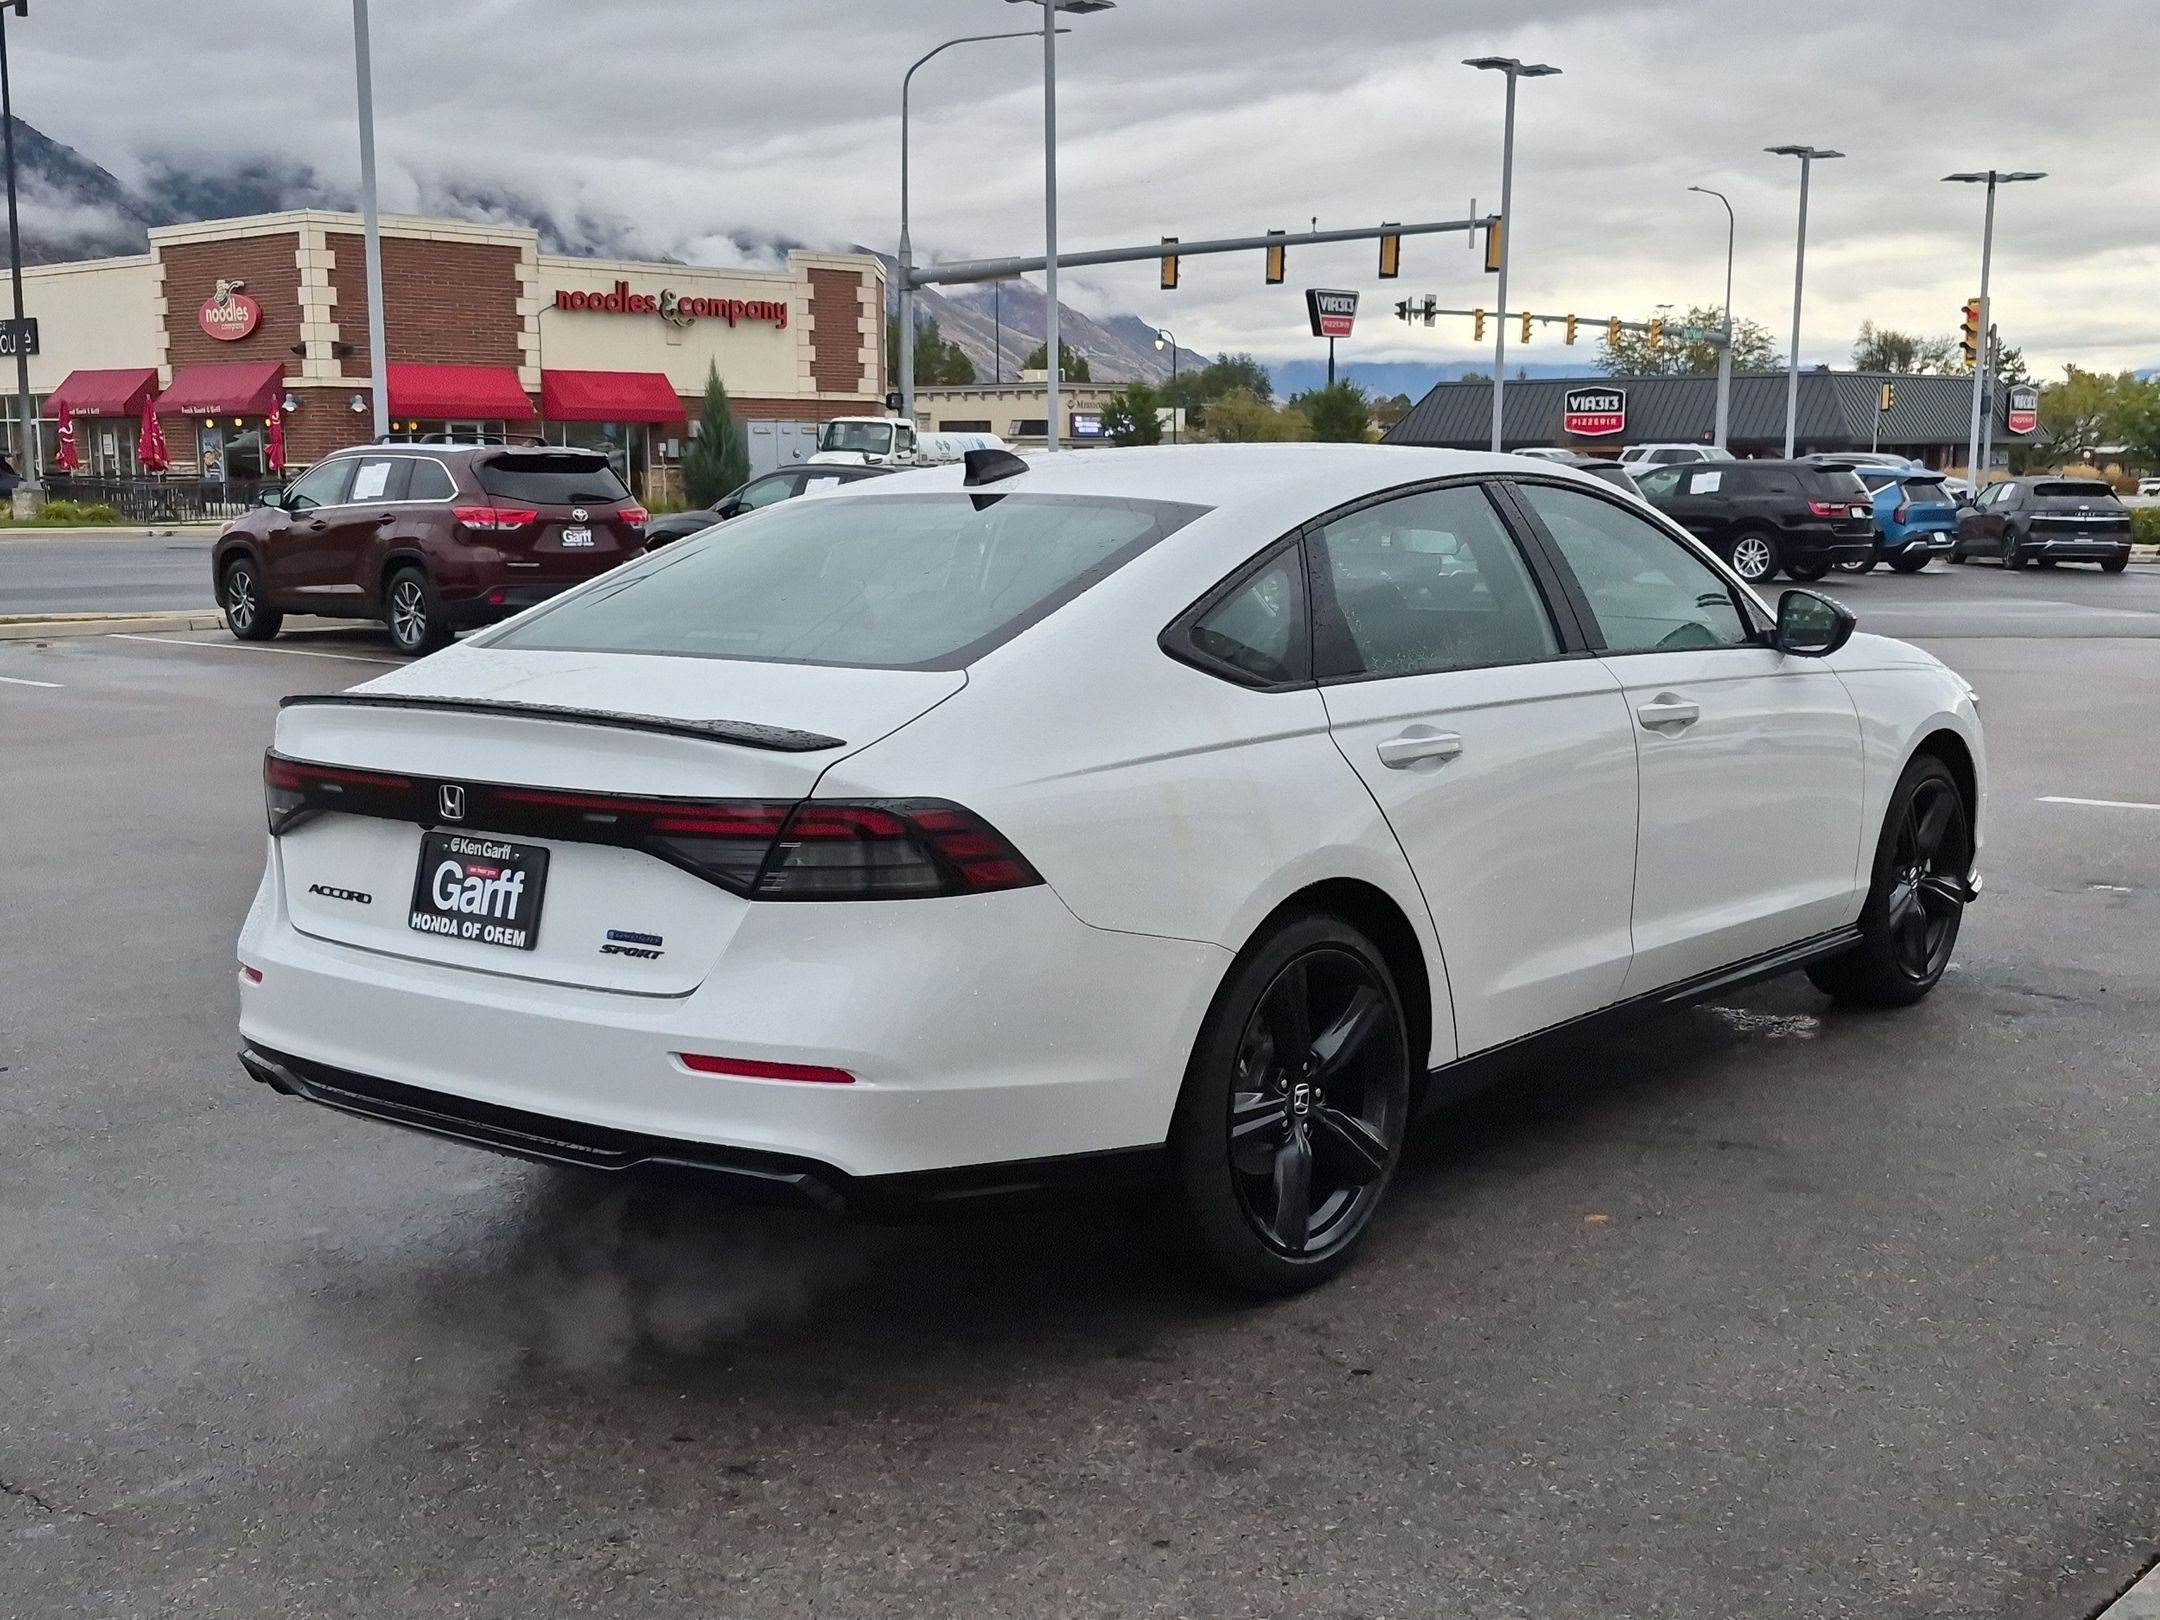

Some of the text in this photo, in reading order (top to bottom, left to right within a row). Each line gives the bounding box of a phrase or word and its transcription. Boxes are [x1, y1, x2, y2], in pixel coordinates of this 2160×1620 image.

[205, 298, 249, 323] noodles
[556, 280, 788, 329] noodles & company
[1569, 396, 1619, 411] VIA313
[1572, 417, 1617, 426] PIZZERIA
[562, 529, 592, 542] Garff
[459, 838, 512, 860] Ken Garff
[308, 883, 373, 905] ACCORD
[432, 860, 526, 920] Garff
[411, 912, 526, 948] HONDA OF OREM
[599, 944, 665, 960] SPORT
